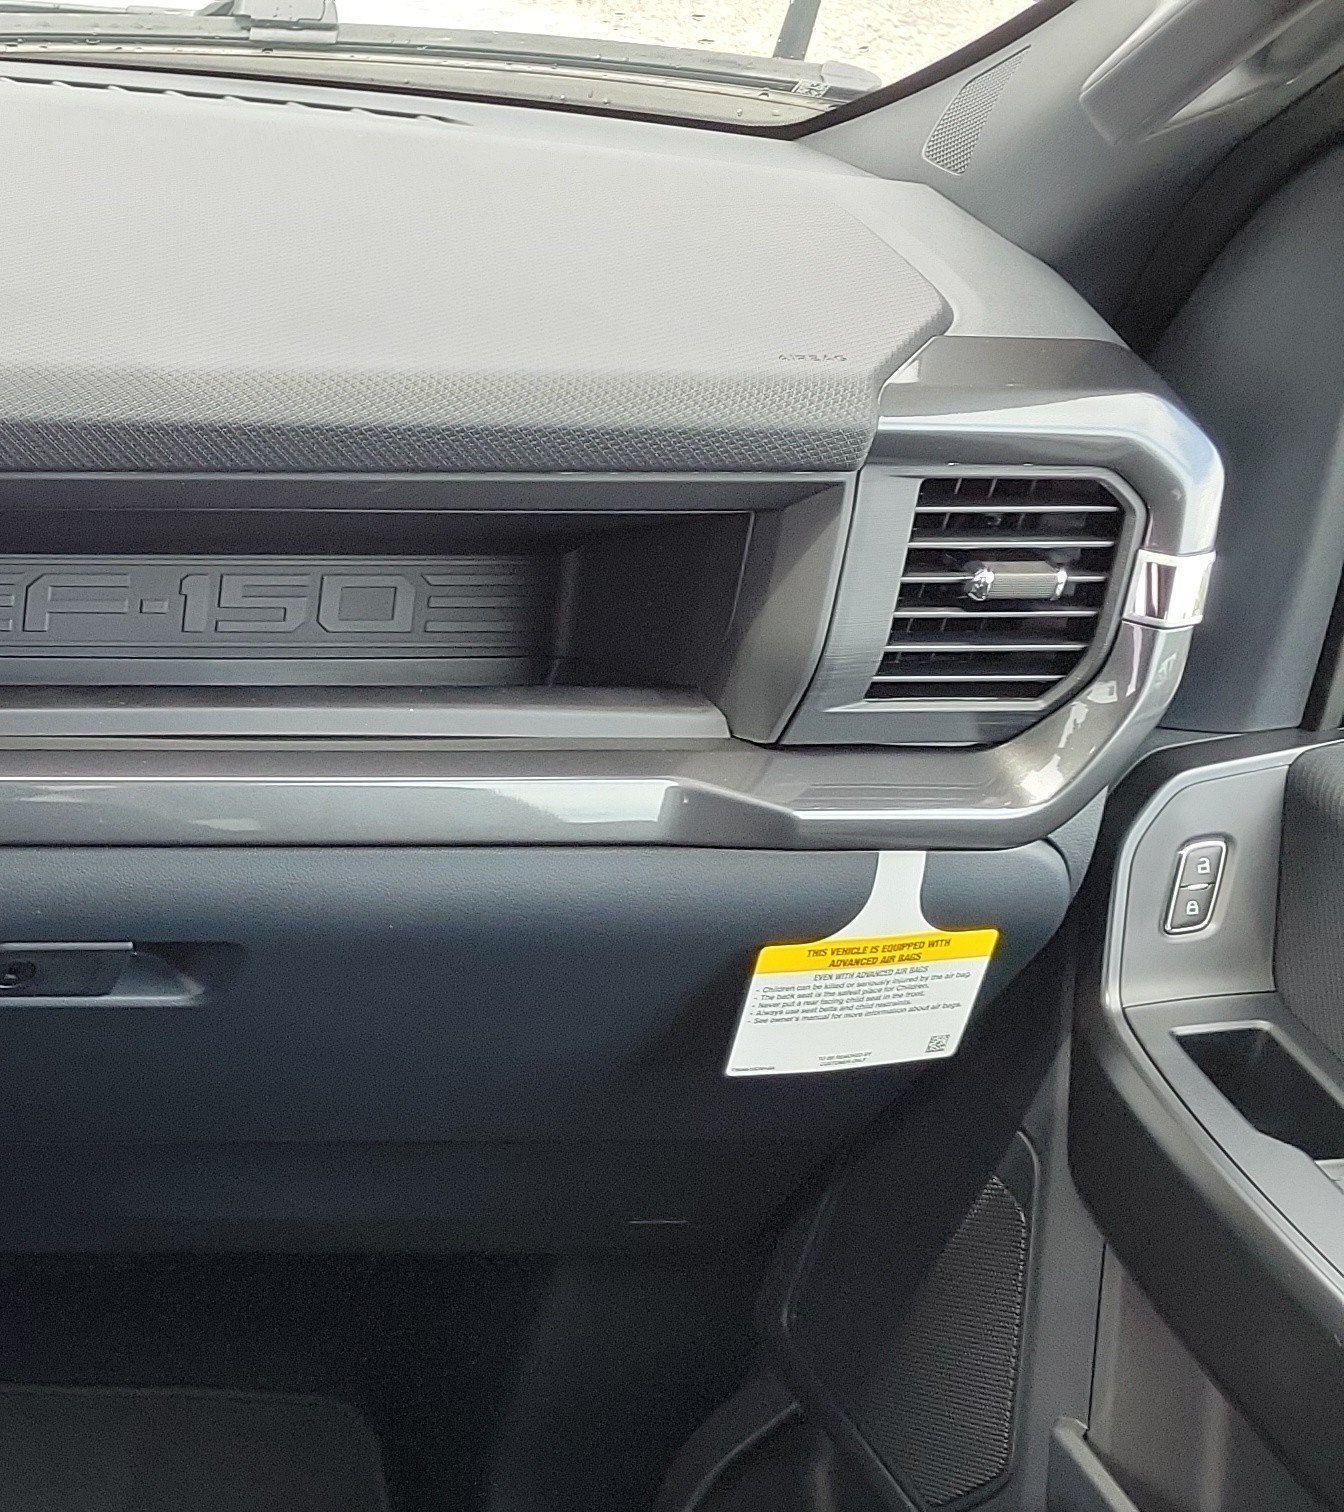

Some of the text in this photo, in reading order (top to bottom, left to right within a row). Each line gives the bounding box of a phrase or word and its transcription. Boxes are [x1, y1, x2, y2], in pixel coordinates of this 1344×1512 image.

[24, 571, 418, 633] F-150
[806, 949, 827, 957] THIS
[830, 946, 868, 956] VEHICLE
[881, 941, 925, 953] EQUIPPED
[928, 939, 951, 948] WITH
[828, 953, 922, 968] ADVANCED AIR BAGS
